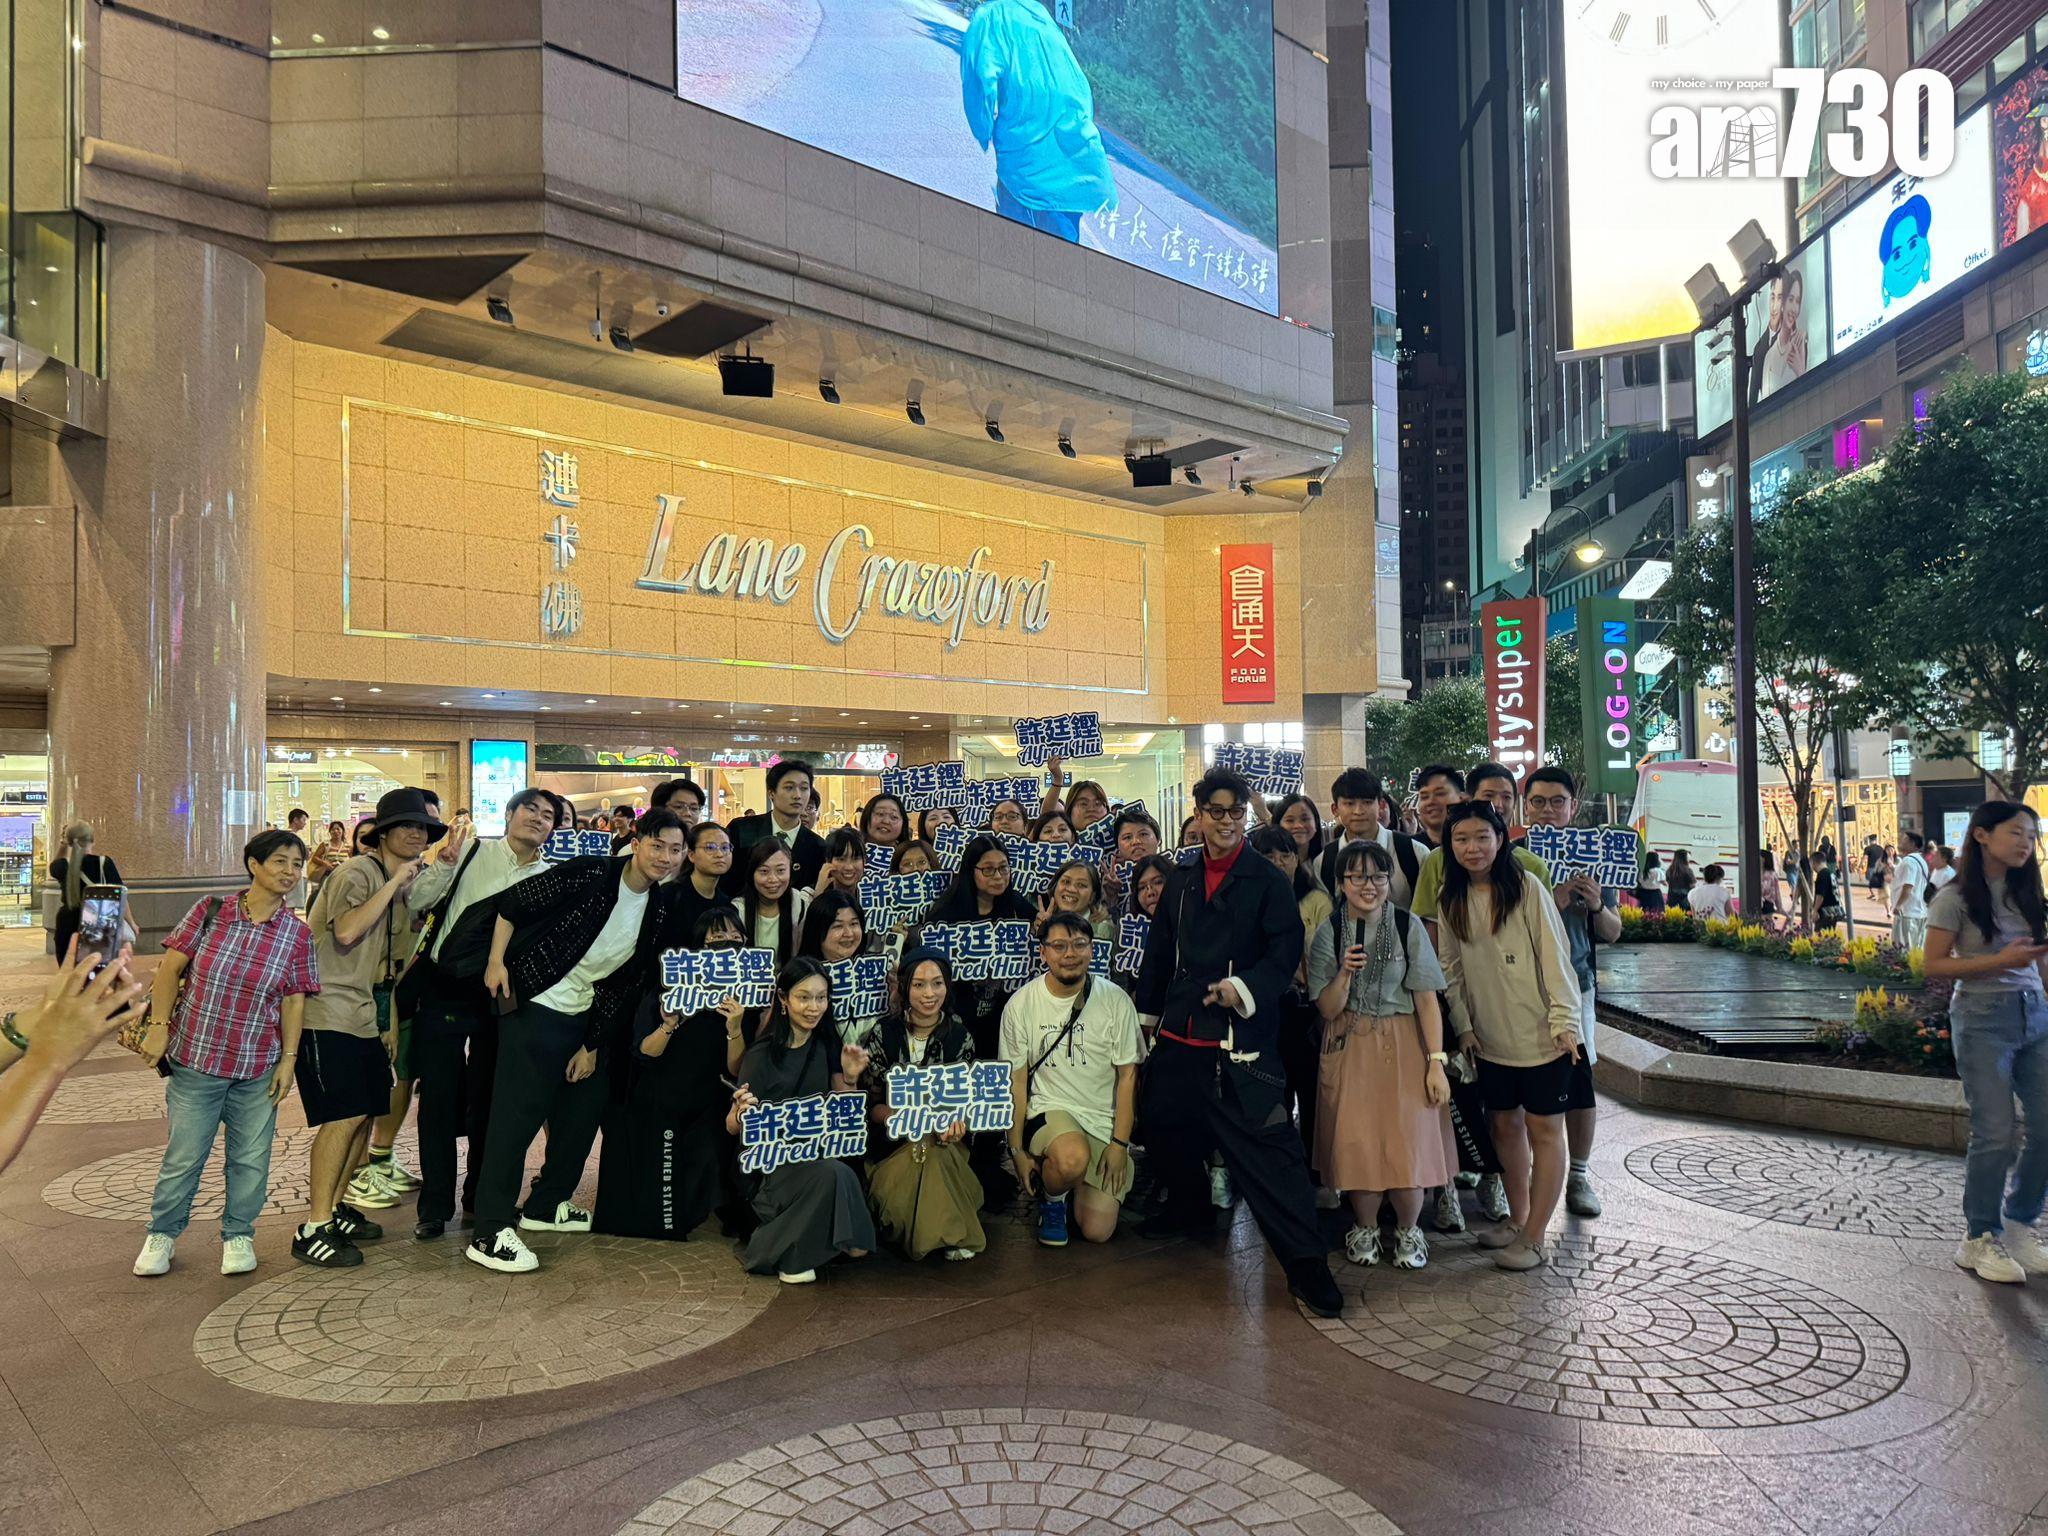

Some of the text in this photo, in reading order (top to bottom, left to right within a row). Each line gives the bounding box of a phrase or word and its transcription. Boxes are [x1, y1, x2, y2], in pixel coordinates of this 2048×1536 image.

[541, 449, 583, 640] 連卡佛
[635, 493, 1056, 650] Lane Crawford
[1229, 564, 1266, 660] 食通天
[1230, 668, 1267, 676] FOOD
[1230, 676, 1267, 684] FORUM
[1602, 620, 1632, 769] LOG-ON
[1016, 712, 1101, 747] 許廷鏗
[1073, 737, 1103, 758] Hui
[935, 789, 967, 809] Hui
[1266, 777, 1301, 796] Hui
[540, 829, 612, 859] 廷鏗
[1529, 825, 1638, 866] 許廷鏗
[1598, 863, 1638, 888] Hui
[922, 920, 1031, 958] 許廷鏗
[662, 950, 776, 987] 許廷鏗
[824, 957, 887, 997] 廷鏗
[991, 954, 1030, 979] Hui
[737, 983, 776, 1009] Hui
[853, 991, 889, 1018] Hui
[889, 1062, 1010, 1109] 許廷鏗
[743, 1095, 867, 1145] 許廷鏗
[887, 1103, 1012, 1141] Alfred Hui
[741, 1132, 868, 1174] Alfred Hui
[662, 1141, 674, 1230] ALFRED STATION
